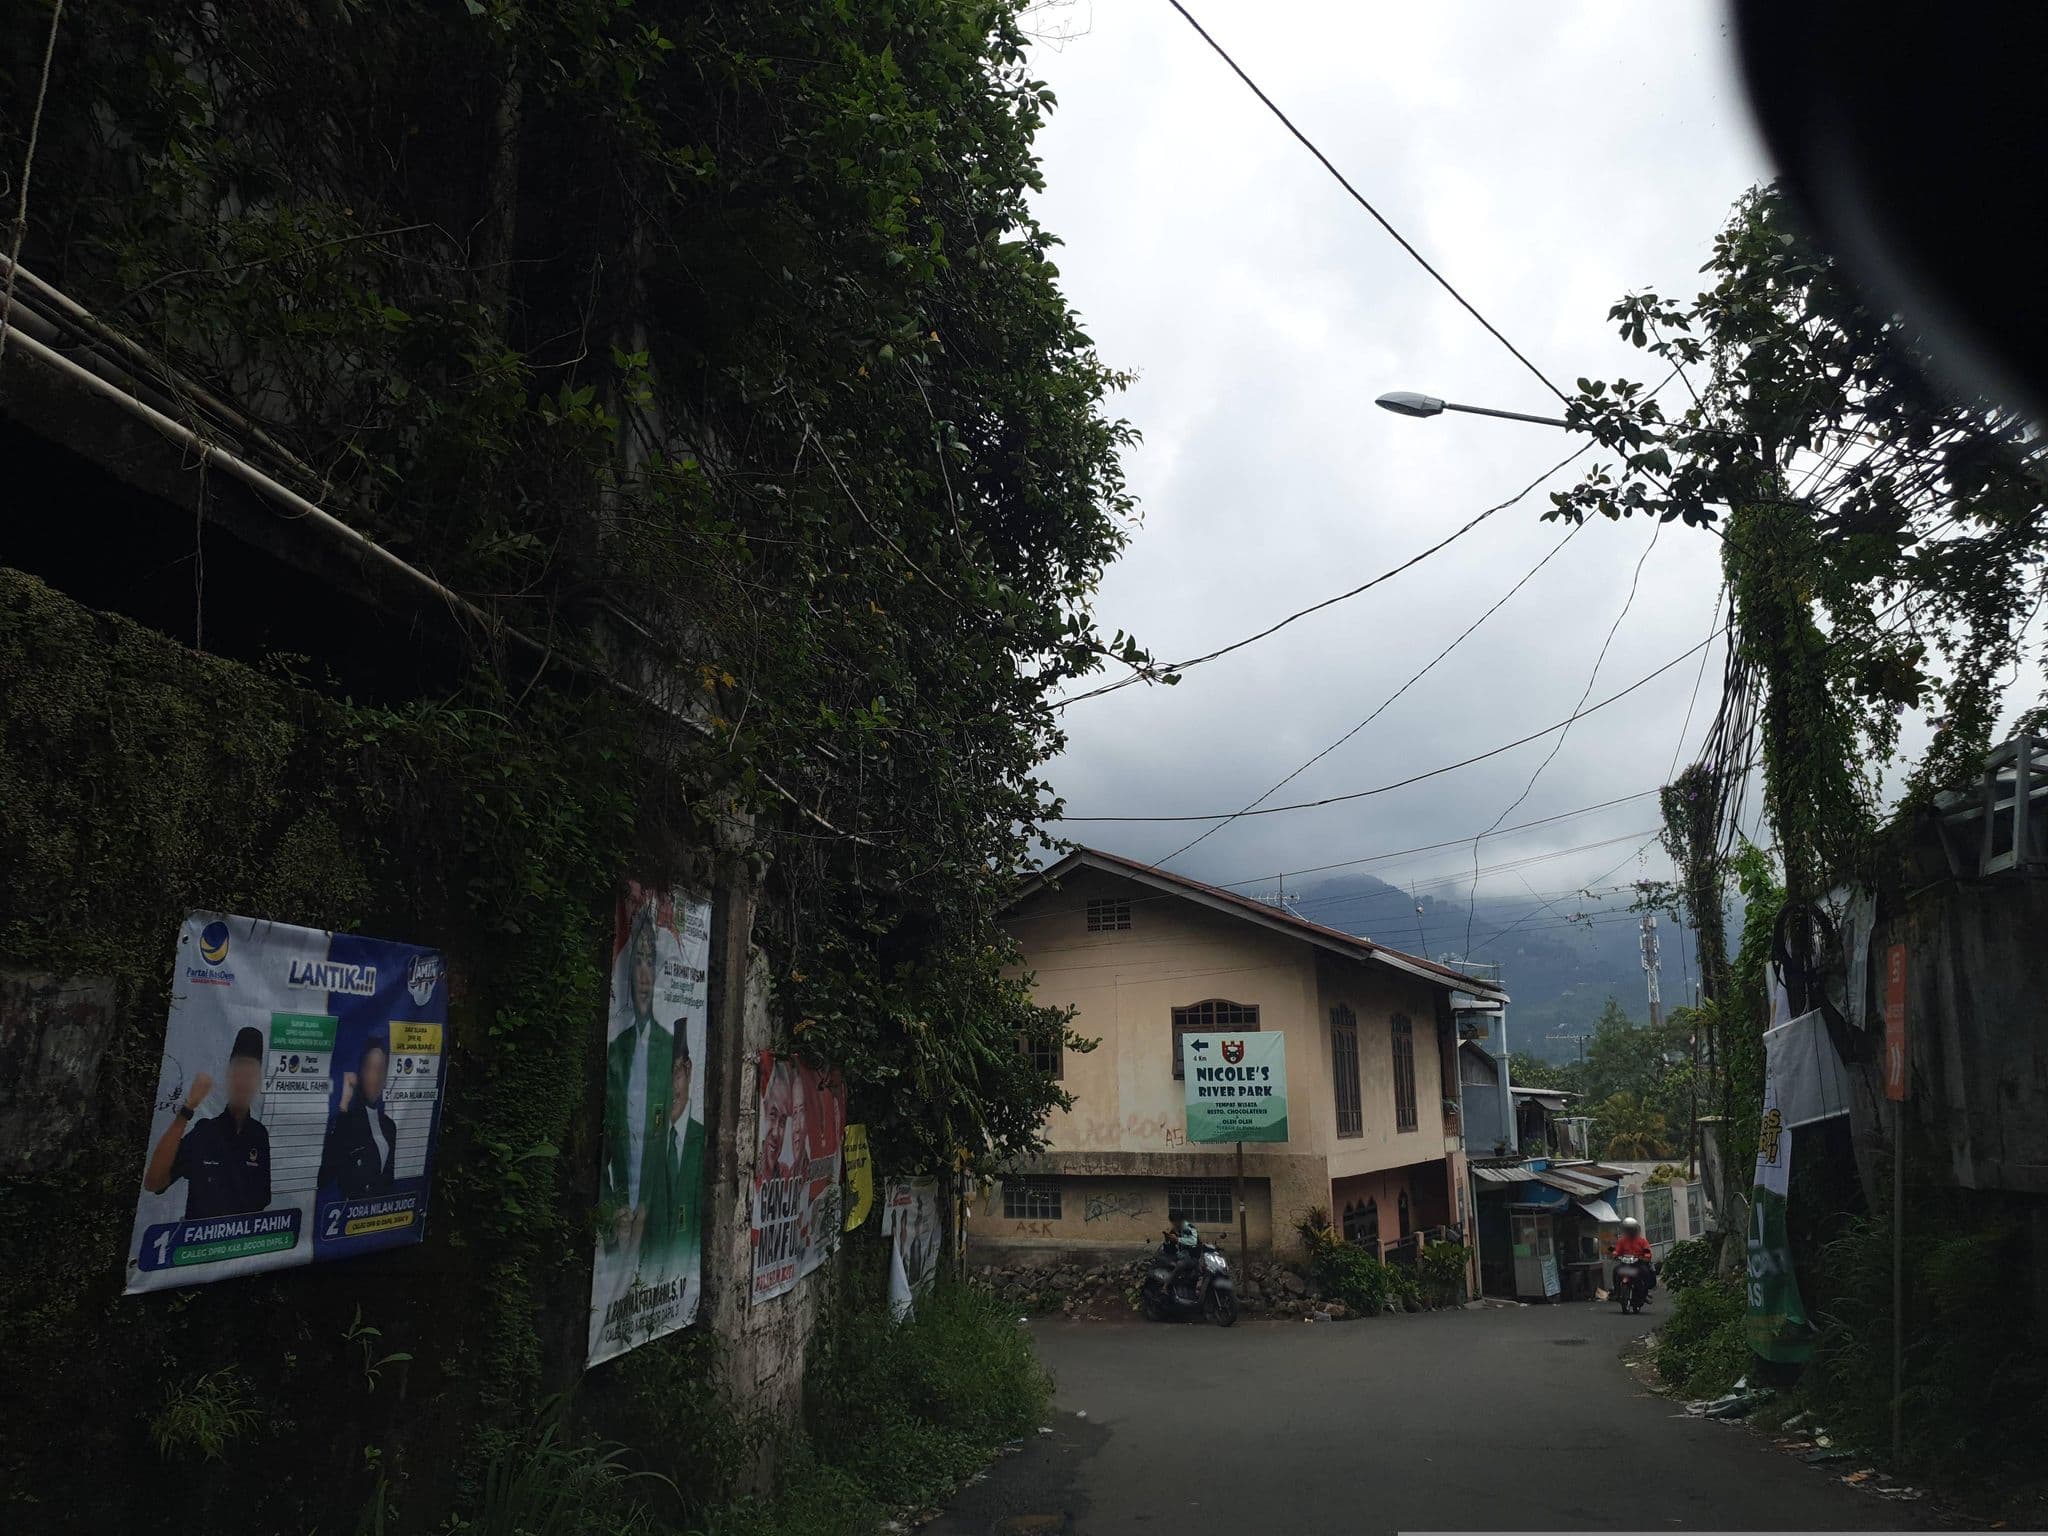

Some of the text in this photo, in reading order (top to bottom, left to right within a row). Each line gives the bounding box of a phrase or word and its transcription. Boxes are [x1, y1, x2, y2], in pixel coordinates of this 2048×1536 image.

[280, 1055, 287, 1072] 5
[396, 1058, 403, 1074] 5
[1196, 1066, 1270, 1082] NICOLE'S
[1198, 1085, 1272, 1097] RIVER PARK
[760, 1178, 803, 1223] GANJA
[325, 1208, 341, 1237] 2
[346, 1206, 369, 1219] JORA
[153, 1214, 292, 1265] 1 FAHIRMAL FAHIM
